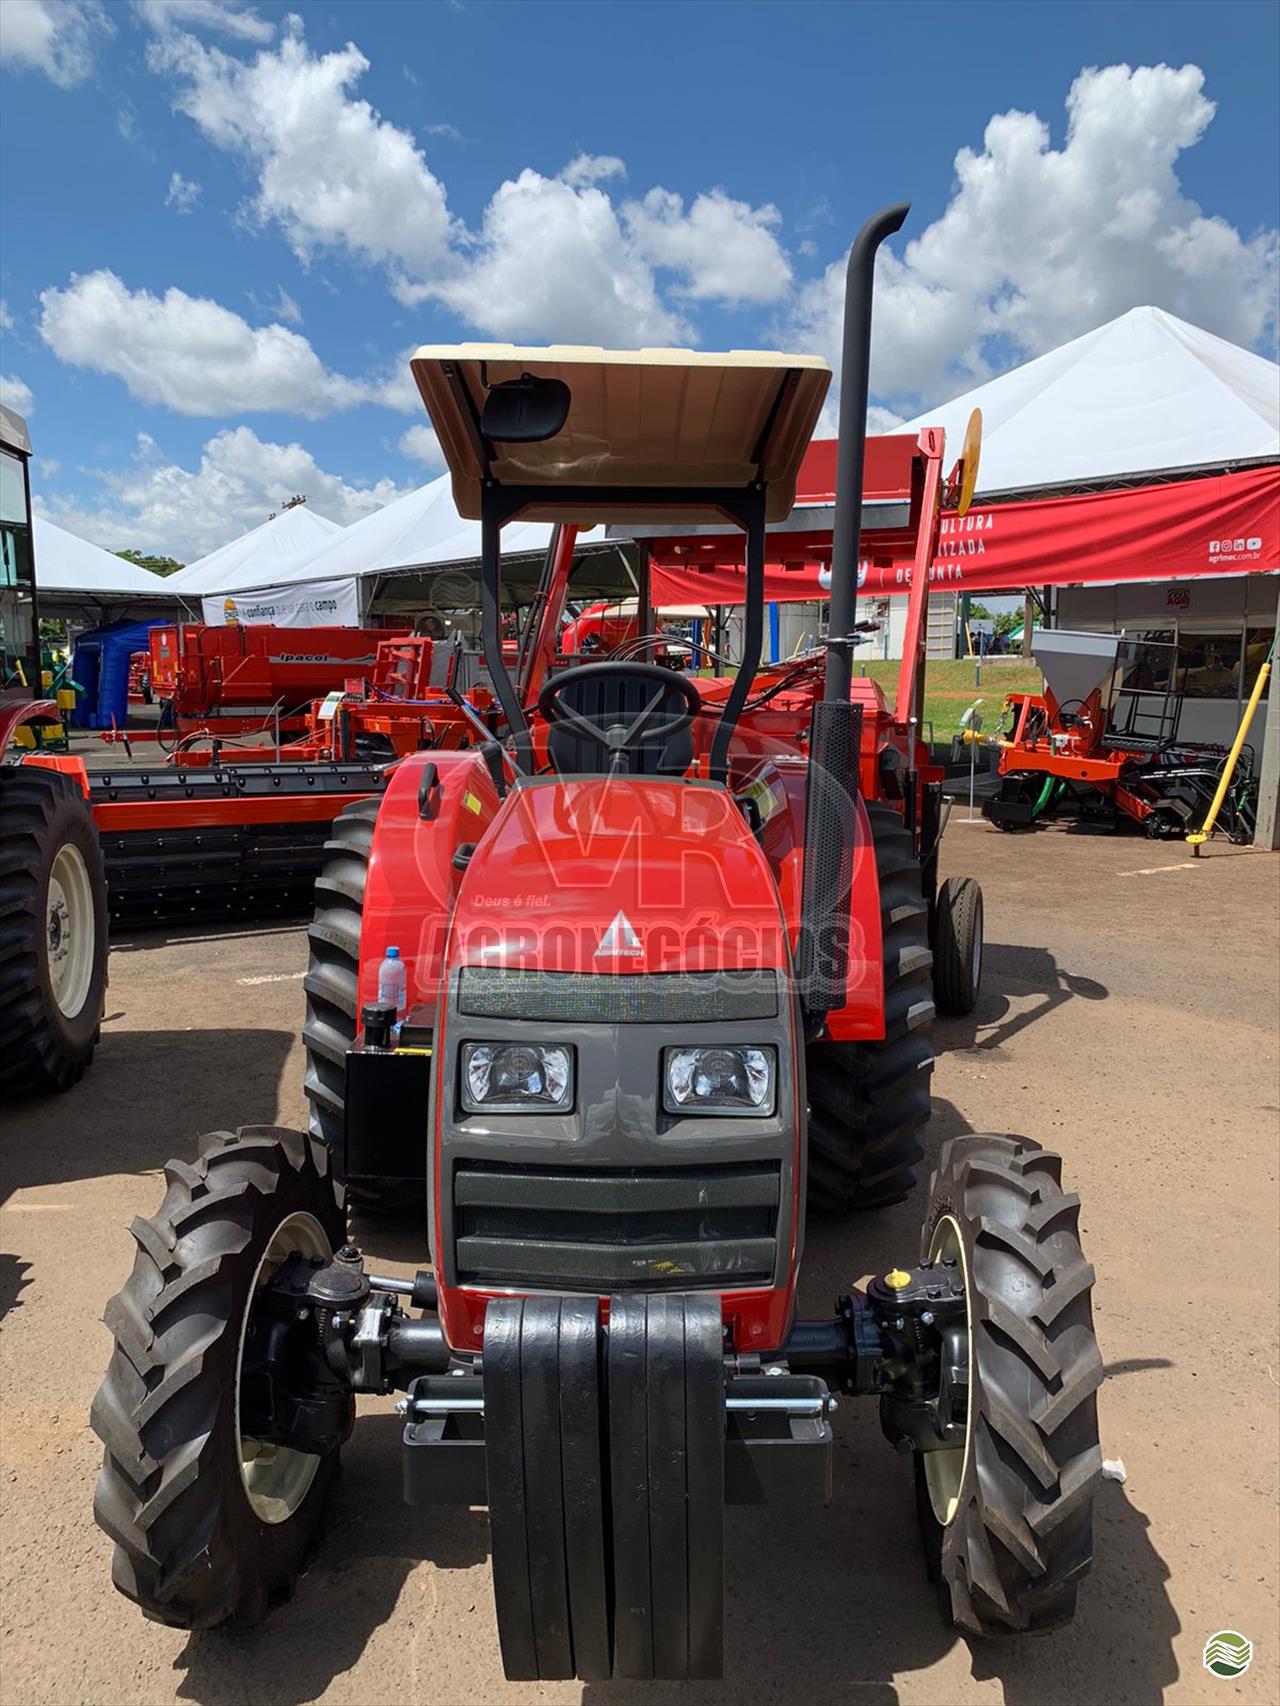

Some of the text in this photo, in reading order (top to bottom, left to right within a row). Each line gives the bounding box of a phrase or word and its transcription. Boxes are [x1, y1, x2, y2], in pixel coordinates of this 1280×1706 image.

[940, 514, 993, 534] ULTURA
[938, 538, 985, 557] IZADA
[1208, 552, 1261, 563] agrimec.com.br
[247, 604, 276, 619] confiança
[315, 599, 337, 614] campo
